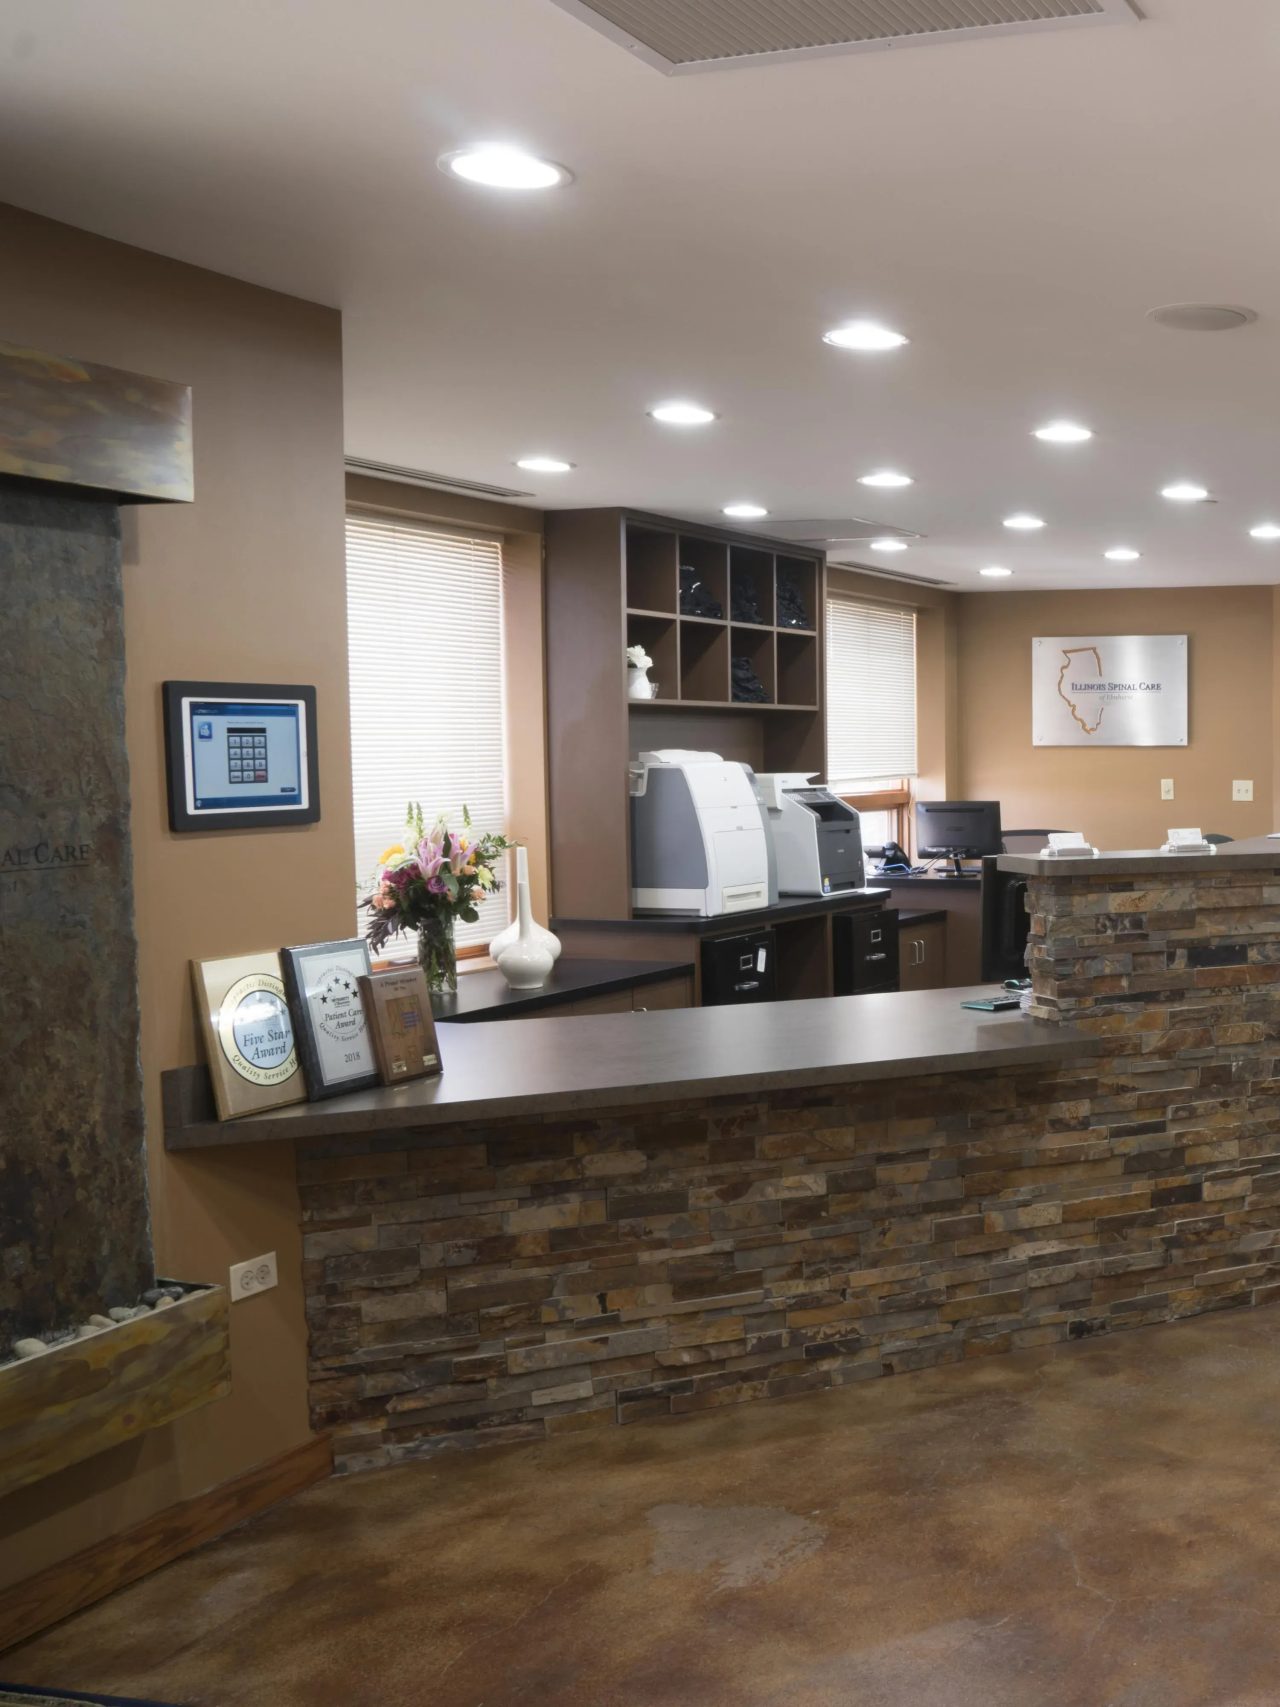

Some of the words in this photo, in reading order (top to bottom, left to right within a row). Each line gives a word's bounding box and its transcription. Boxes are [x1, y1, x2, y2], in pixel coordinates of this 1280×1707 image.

[1107, 682, 1138, 691] SPINAL
[1139, 682, 1162, 691] CARE
[325, 1009, 347, 1021] Patient
[335, 1018, 356, 1030] Award
[243, 1033, 265, 1047] Five
[267, 1029, 291, 1042] Star
[252, 1042, 286, 1060] Award
[344, 1051, 361, 1063] 2018
[232, 1054, 261, 1080] Quality
